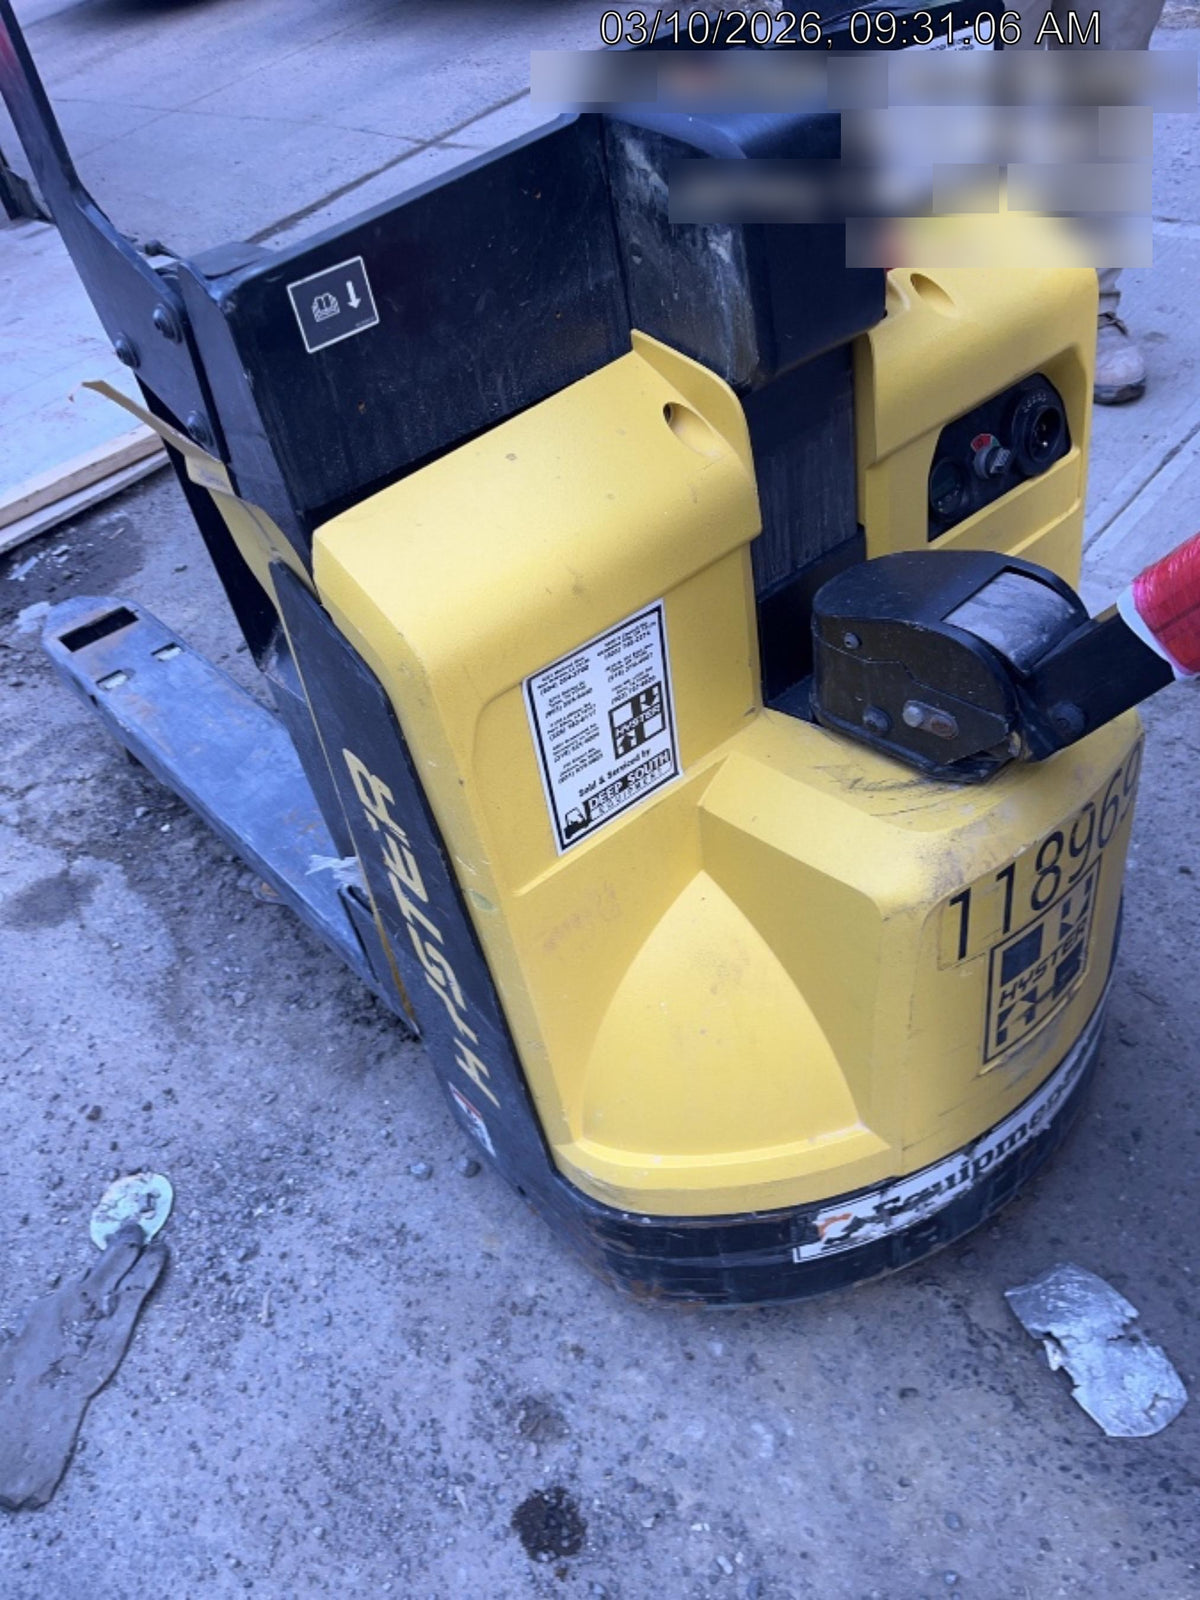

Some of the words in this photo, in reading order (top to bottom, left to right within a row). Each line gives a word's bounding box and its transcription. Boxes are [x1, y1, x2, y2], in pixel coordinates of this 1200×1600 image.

[578, 780, 596, 797] Sold
[598, 776, 606, 785] &
[607, 754, 640, 779] Serviced
[641, 748, 651, 758] by
[588, 781, 623, 808] DEEP
[627, 750, 671, 783] SOUTH
[948, 740, 1142, 961] 118969
[342, 747, 501, 1110] HYSTER
[997, 917, 1088, 1009] HYSTER
